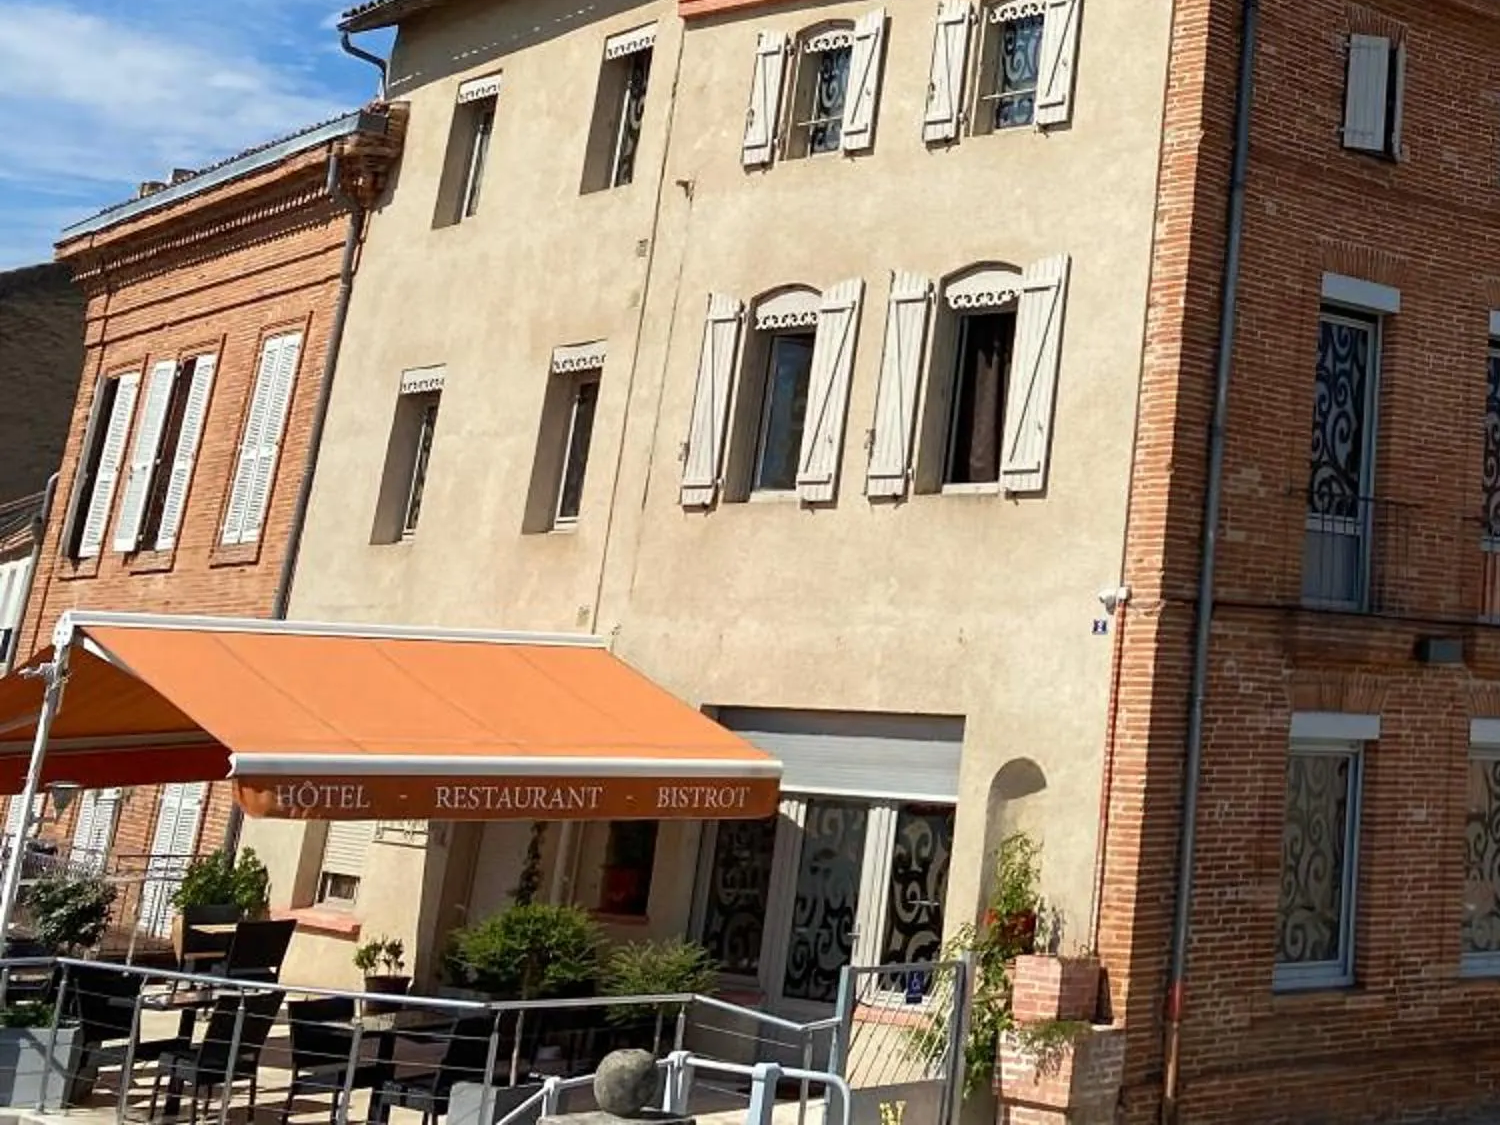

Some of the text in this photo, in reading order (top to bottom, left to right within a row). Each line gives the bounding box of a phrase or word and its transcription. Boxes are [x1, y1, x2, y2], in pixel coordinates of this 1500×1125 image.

[275, 780, 371, 809] HÔTEL
[435, 785, 604, 810] RESTAURANT
[656, 785, 751, 809] BISTROT
